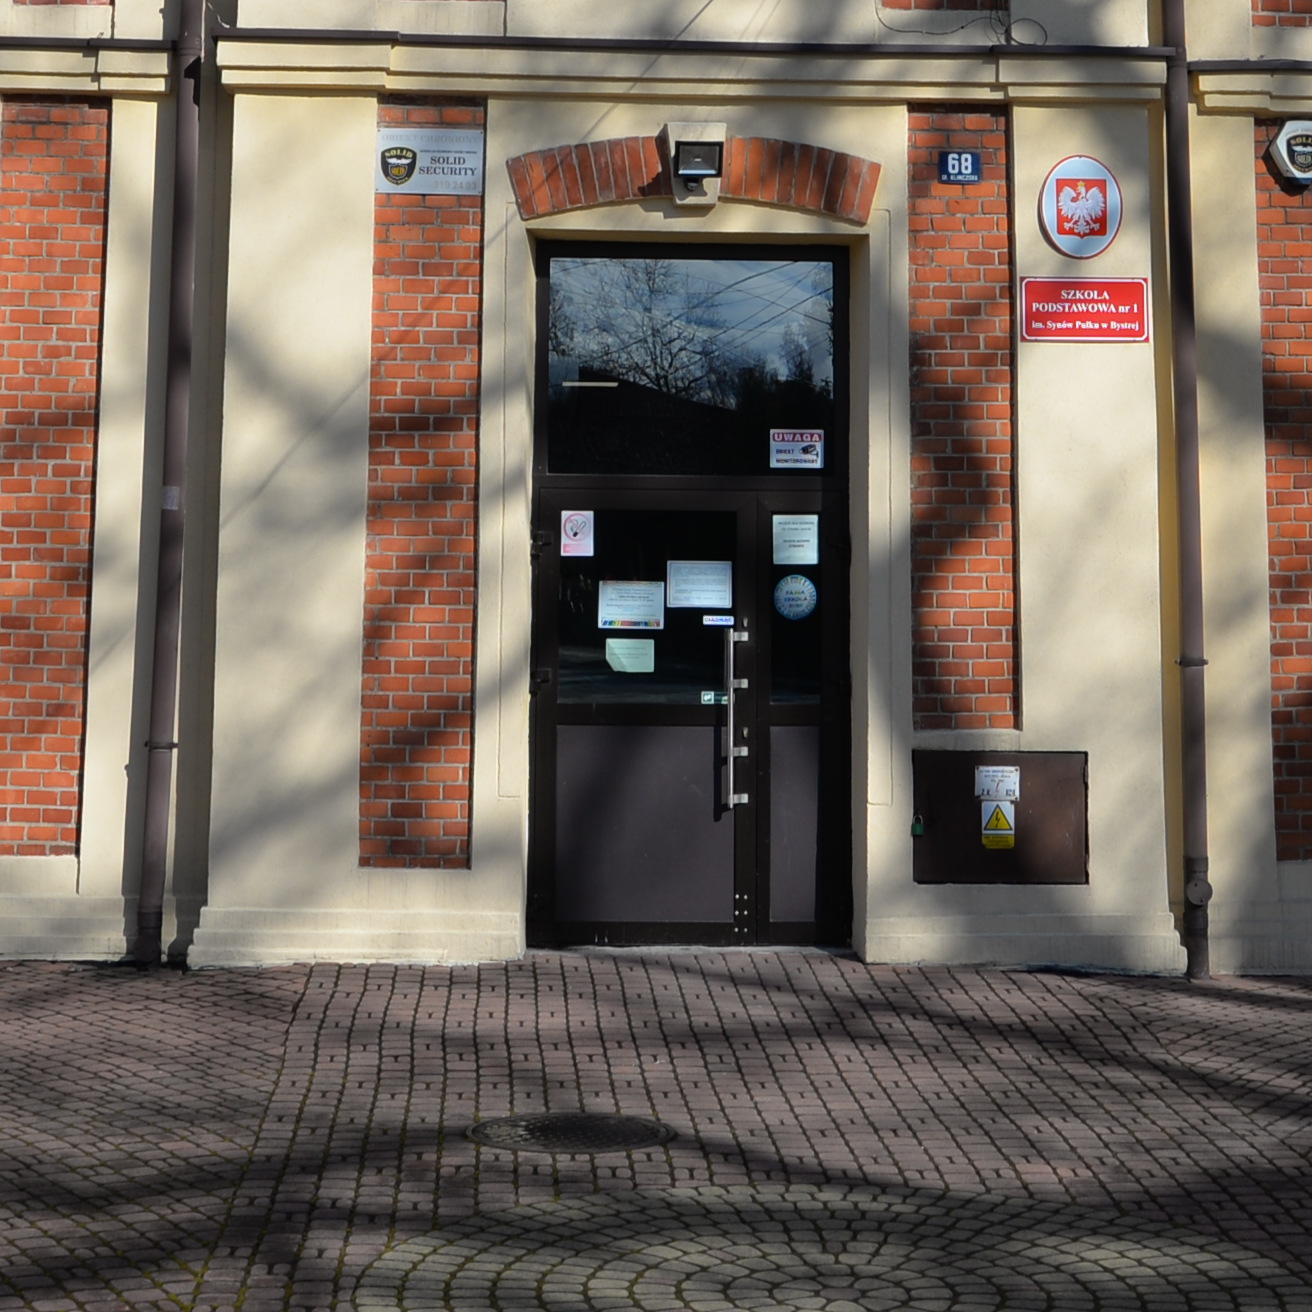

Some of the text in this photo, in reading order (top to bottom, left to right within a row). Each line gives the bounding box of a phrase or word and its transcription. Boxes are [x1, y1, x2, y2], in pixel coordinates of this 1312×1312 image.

[385, 148, 414, 158] SOLID
[430, 156, 466, 166] SOLID
[948, 153, 972, 174] 68
[419, 166, 477, 177] SECURITY
[1061, 290, 1110, 300] SZKOŁA
[1032, 303, 1138, 313] PODSTAWOWA nr 1
[1047, 320, 1073, 331] Synów
[1110, 321, 1139, 331] Bystrej
[774, 433, 820, 442] UWAGA
